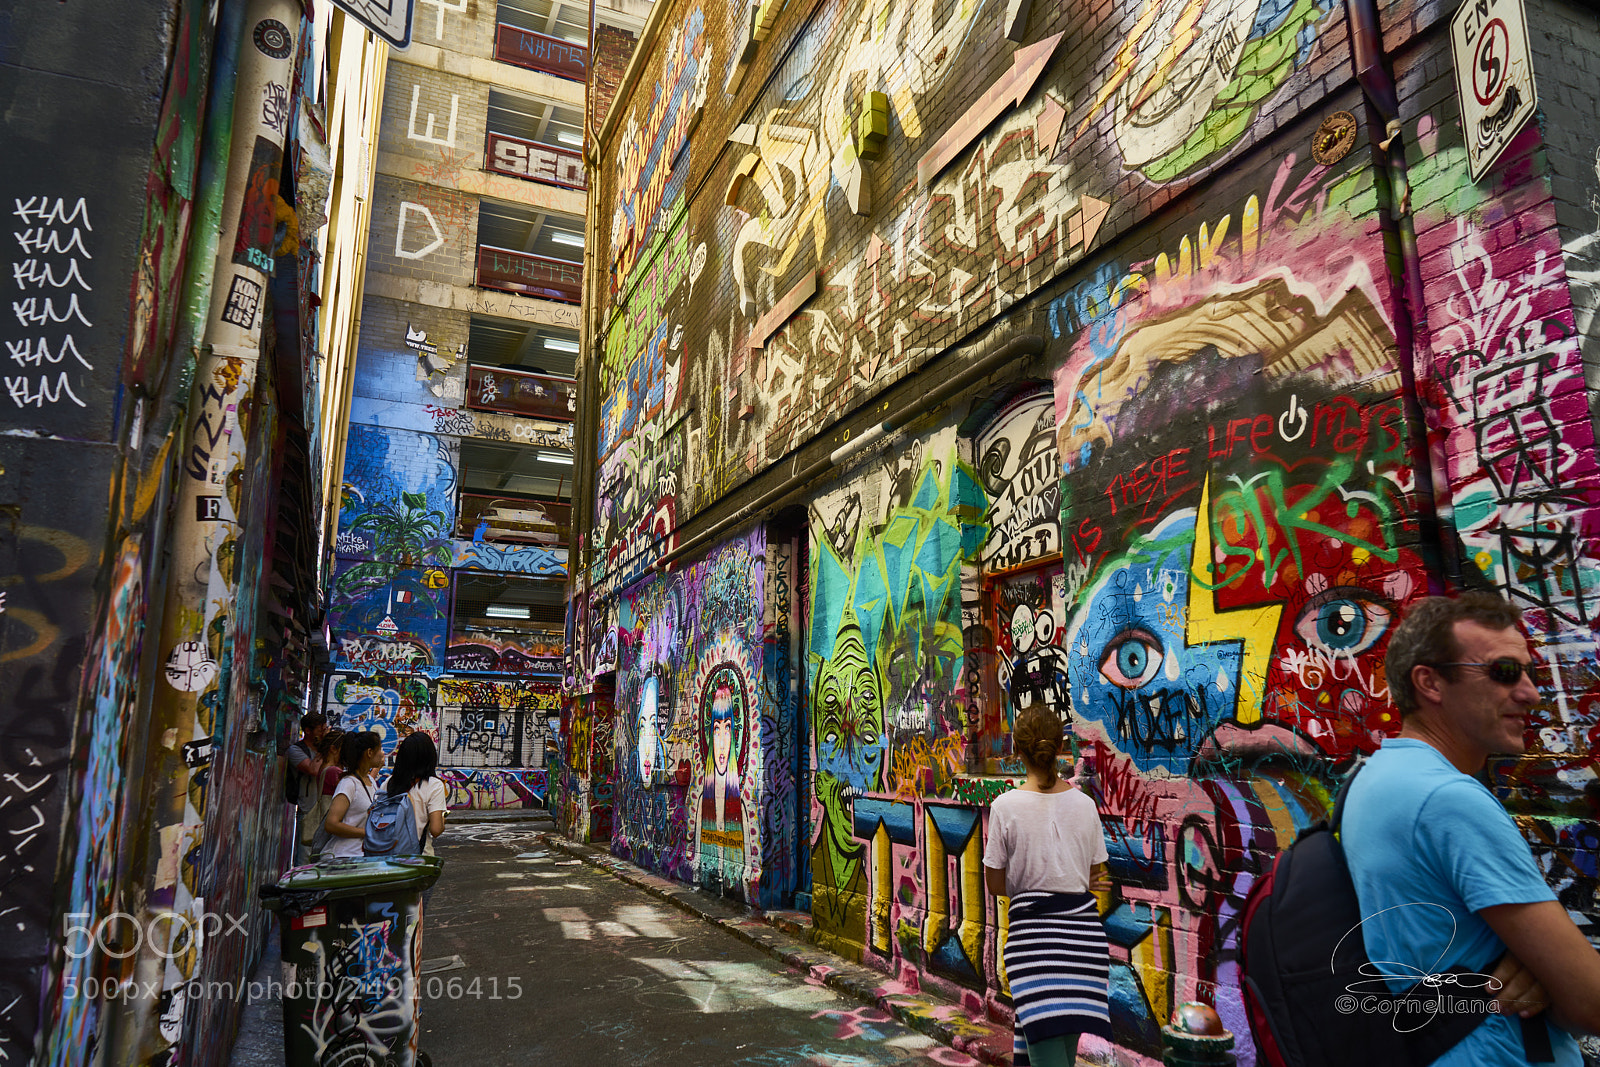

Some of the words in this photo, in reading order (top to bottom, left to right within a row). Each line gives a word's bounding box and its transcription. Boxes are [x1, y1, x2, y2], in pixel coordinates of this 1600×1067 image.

[1464, 0, 1496, 46] EN
[520, 34, 585, 67] WHITE
[13, 196, 92, 231] KLM
[14, 227, 92, 259] KLM
[13, 258, 92, 291] KLM
[494, 254, 580, 283] WHITE
[13, 293, 92, 327] KLM
[5, 334, 94, 371] KLM
[4, 371, 86, 408] KLM
